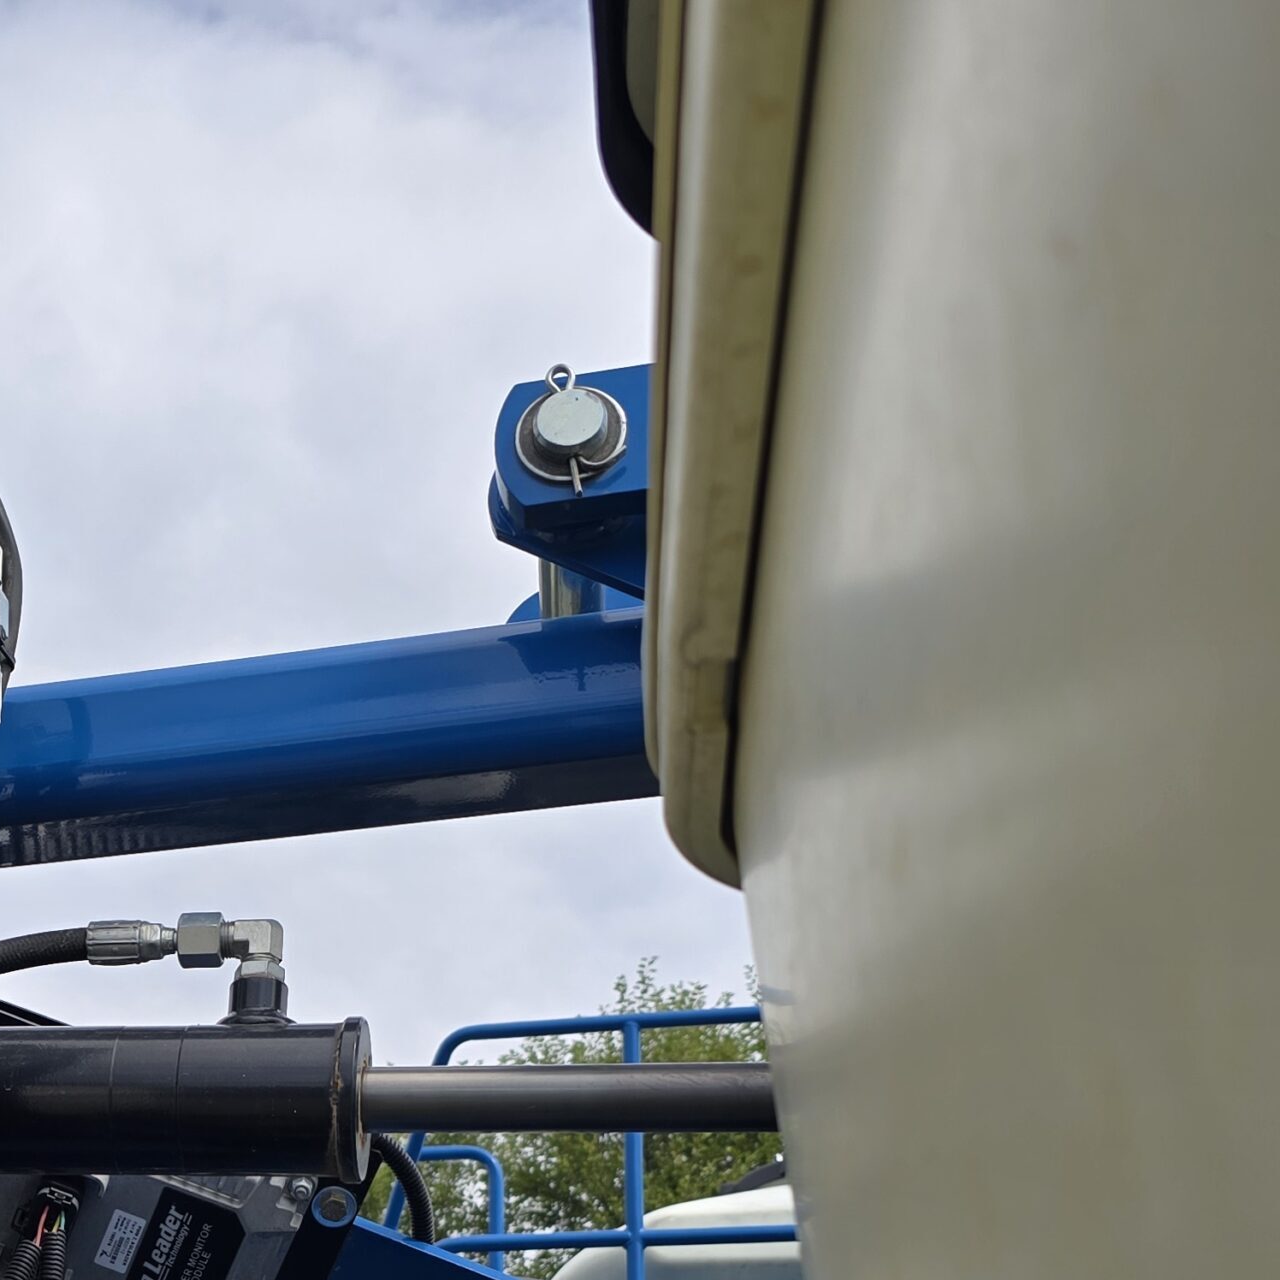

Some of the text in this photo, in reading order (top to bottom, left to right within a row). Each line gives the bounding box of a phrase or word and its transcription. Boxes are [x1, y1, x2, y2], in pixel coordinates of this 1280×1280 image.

[143, 1205, 184, 1275] Leader
[165, 1224, 190, 1268] Technology
[187, 1223, 213, 1268] MONITOR
